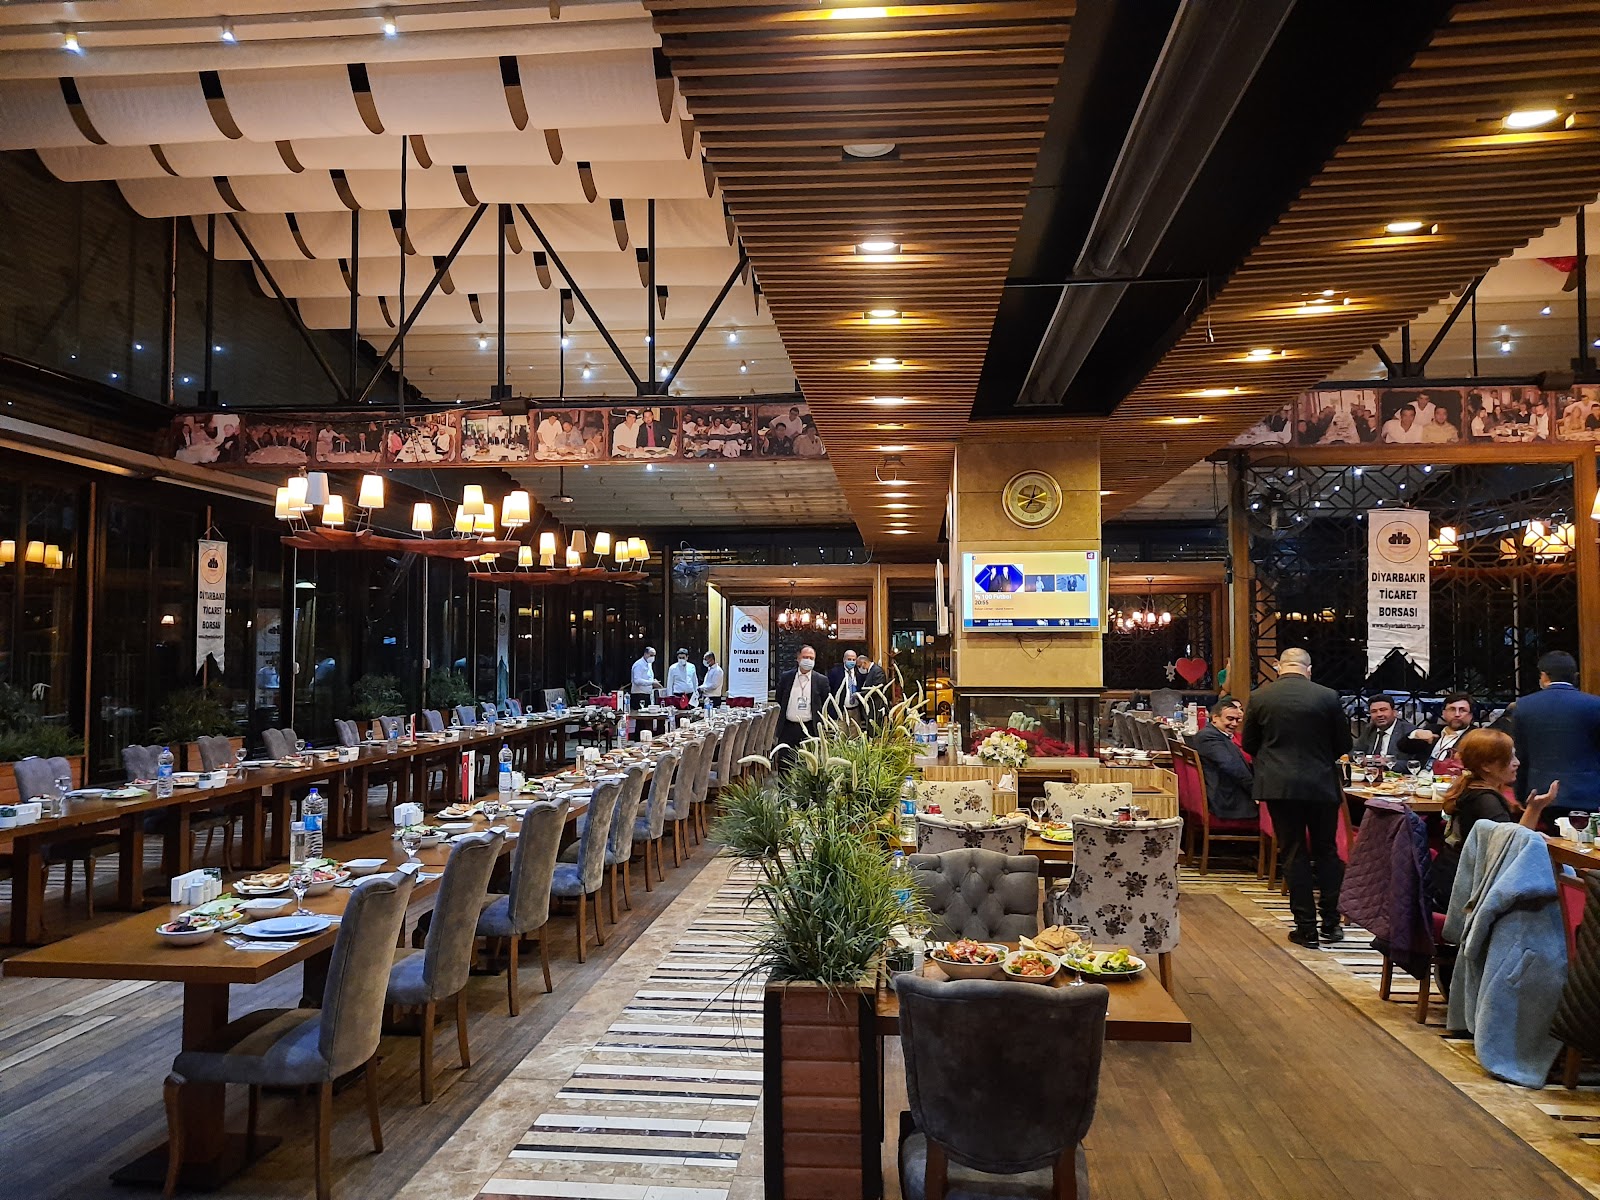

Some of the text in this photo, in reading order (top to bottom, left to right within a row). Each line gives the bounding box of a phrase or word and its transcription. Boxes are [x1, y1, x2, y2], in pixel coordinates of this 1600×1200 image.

[1371, 570, 1426, 583] DİYARBAKIR
[1379, 588, 1418, 600] TİCARET
[1379, 607, 1418, 618] BORSASI
